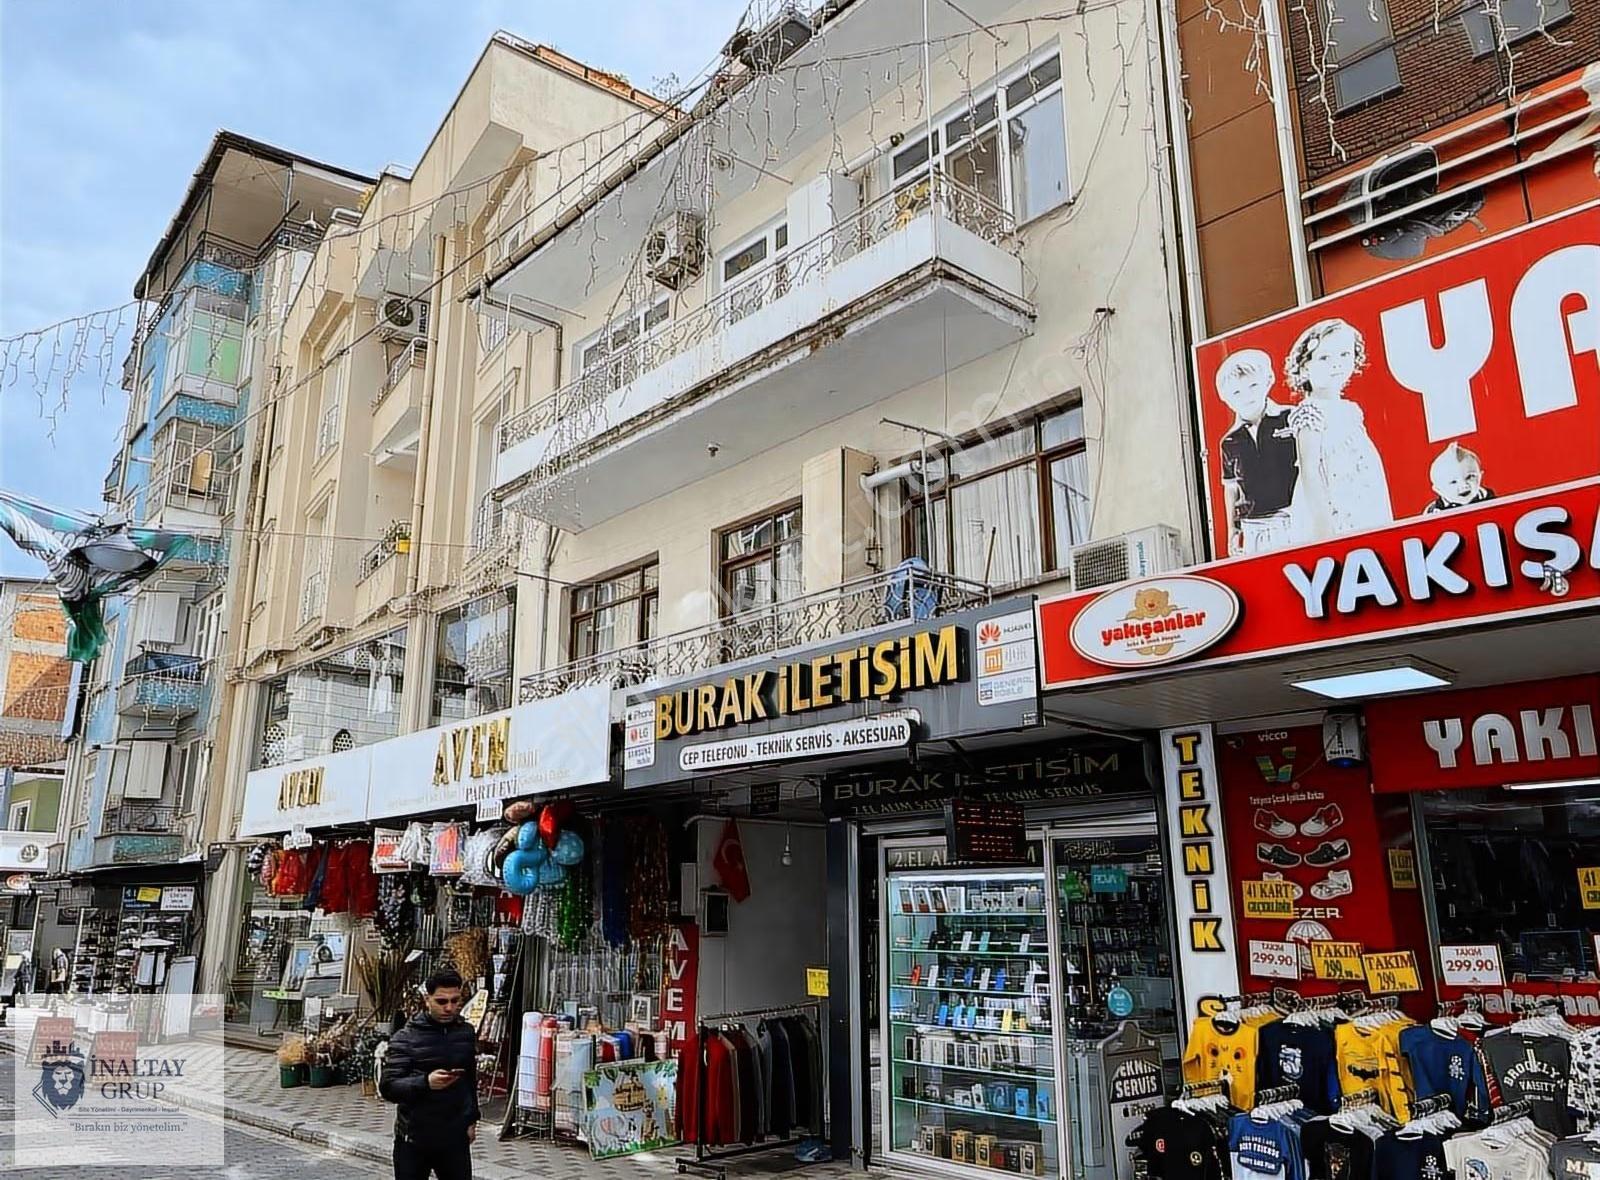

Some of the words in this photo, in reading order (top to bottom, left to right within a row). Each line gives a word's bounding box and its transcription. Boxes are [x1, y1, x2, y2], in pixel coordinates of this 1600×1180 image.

[1283, 505, 1600, 619] YAKIŞ
[1101, 611, 1206, 647] yakışanlar
[655, 670, 770, 741] BURAK
[778, 624, 960, 714] İLETİŞİM
[632, 708, 654, 722] iPhone
[638, 728, 649, 739] LG
[432, 717, 512, 788] AVEM
[682, 749, 699, 766] CEP
[701, 742, 749, 762] TELEFONU
[756, 734, 793, 757] TEKNİK
[795, 730, 833, 752] SERVİS
[843, 725, 906, 746] AKSESUAR
[465, 778, 497, 802] PARTİ
[499, 774, 518, 796] EVİ
[833, 773, 944, 800] BURAK
[916, 797, 949, 812] SATI
[1046, 784, 1103, 799] SERVİS
[1173, 733, 1224, 952] TEKNİK
[894, 851, 926, 868] 2.EL
[1583, 870, 1597, 887] 41
[1293, 907, 1341, 919] EZER
[1252, 951, 1293, 966] 299.90
[1313, 943, 1362, 958] TAKIM
[1455, 948, 1482, 957] TAKIM
[1365, 953, 1413, 971] TAKIM
[1445, 959, 1494, 972] 299.90
[1115, 1074, 1158, 1099] SERVİS
